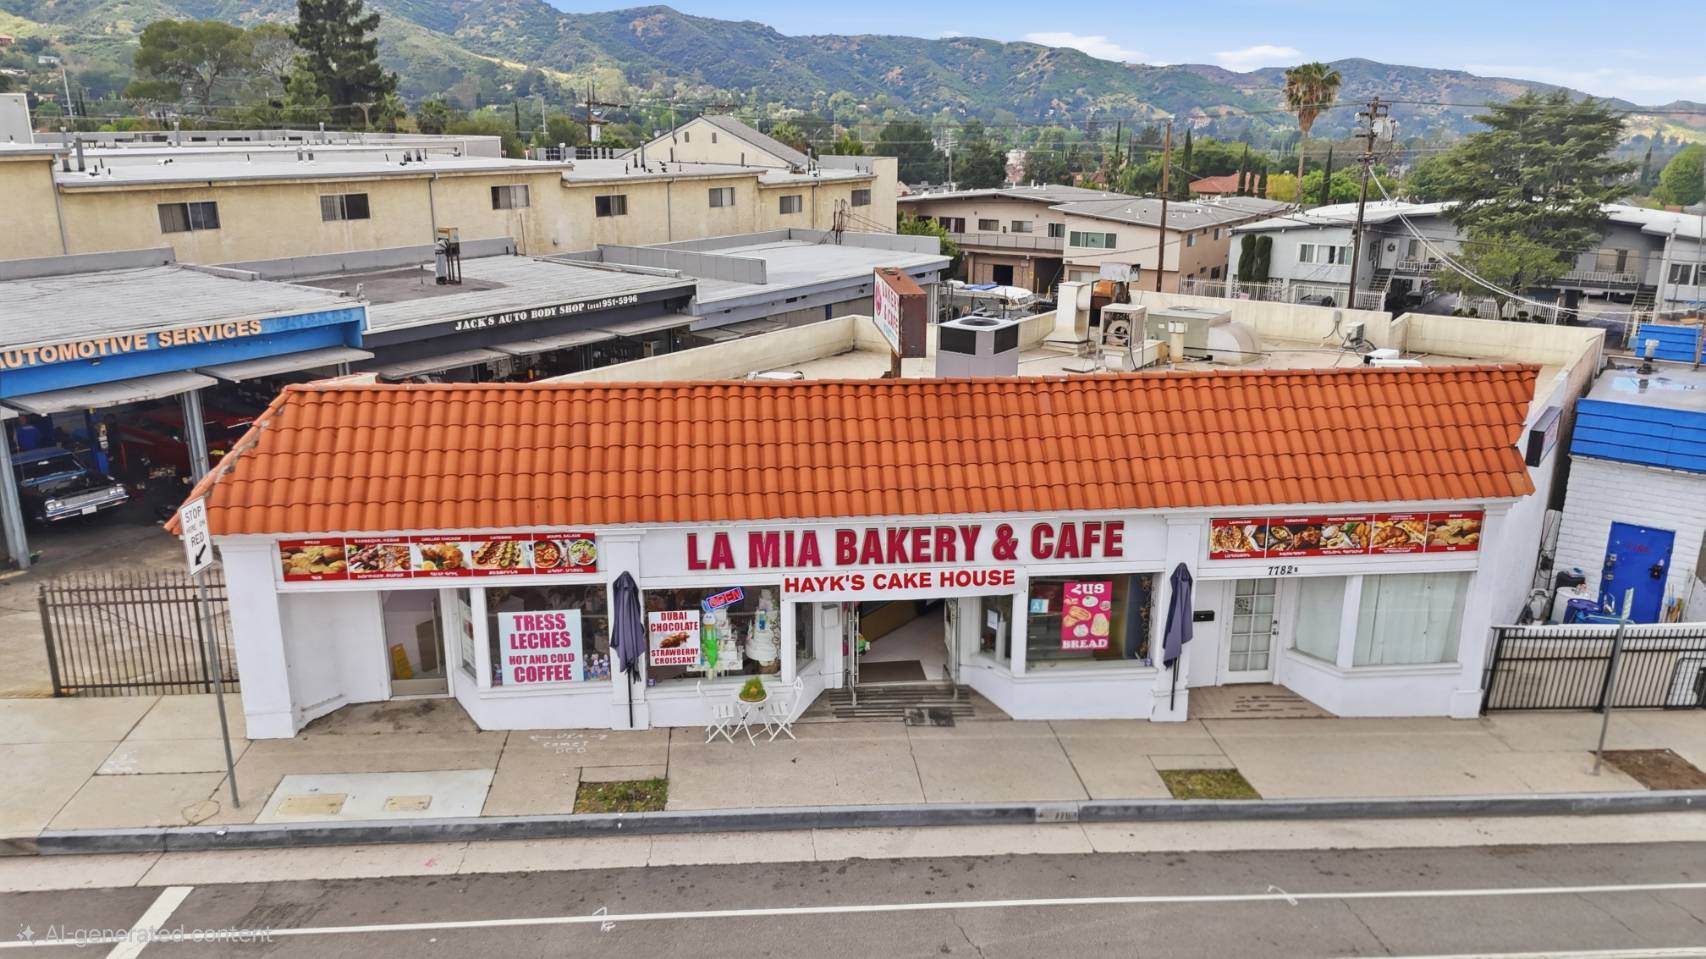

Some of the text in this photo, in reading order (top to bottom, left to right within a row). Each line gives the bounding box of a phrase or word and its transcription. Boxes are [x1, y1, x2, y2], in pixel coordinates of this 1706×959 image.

[456, 317, 495, 331] JACK'S
[499, 311, 528, 324] AUTO
[531, 307, 558, 319] BODY
[559, 302, 585, 314] SHOP
[158, 319, 262, 348] SERVICES
[185, 506, 202, 523] STOP
[191, 532, 205, 548] RED
[687, 520, 1126, 571] LA MIA BAKERY & CAFE
[784, 569, 1016, 593] HAYK'S CAKE HOUSE
[709, 589, 741, 607] OPEN
[513, 613, 567, 631] TRESS
[660, 612, 687, 621] DUBAI
[650, 621, 698, 632] CHOCOLATE
[510, 631, 571, 650] LECHES
[1062, 639, 1108, 649] BREAD
[509, 653, 575, 665] HOT AND COLD
[651, 648, 699, 657] STRAWBERRY
[513, 664, 572, 683] COFFEE
